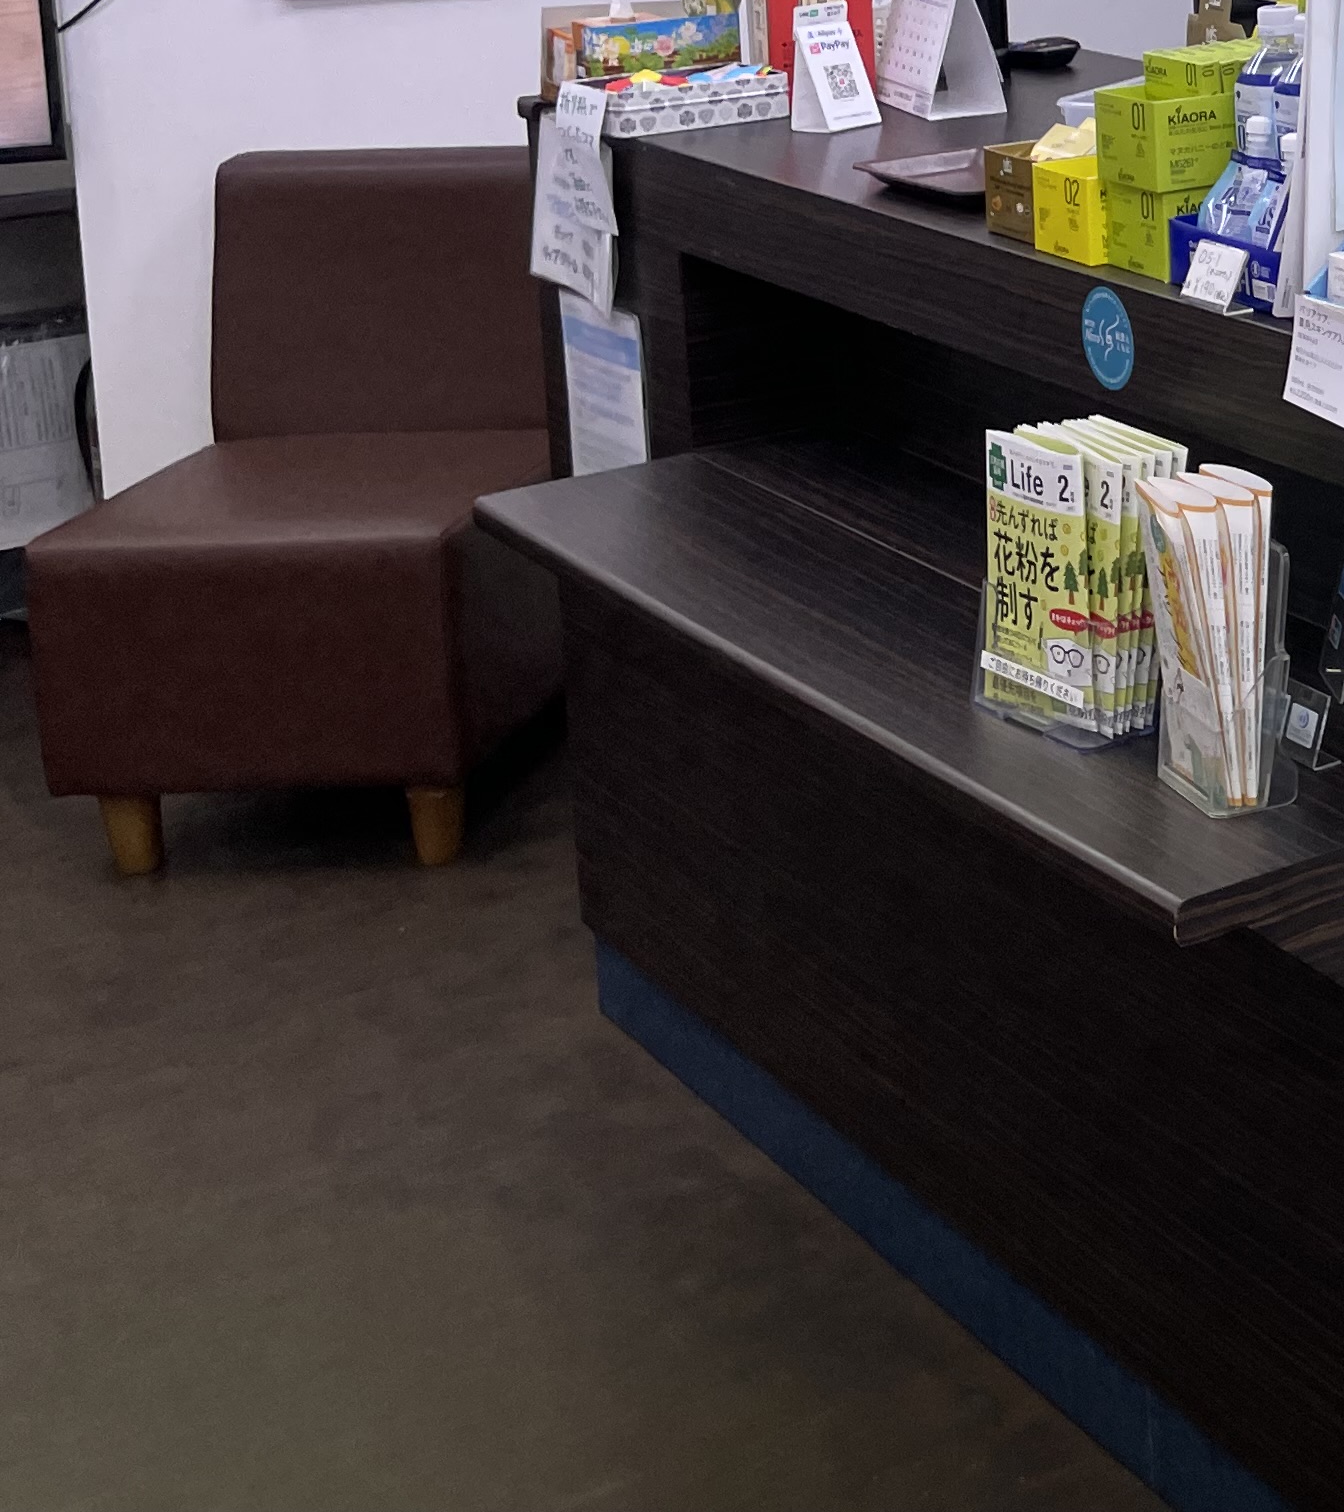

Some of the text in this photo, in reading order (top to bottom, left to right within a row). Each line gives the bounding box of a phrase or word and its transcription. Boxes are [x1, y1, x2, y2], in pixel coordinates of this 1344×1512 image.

[820, 38, 851, 52] PayPay
[1131, 103, 1146, 131] 01
[1168, 105, 1217, 126] KIAORA
[1064, 178, 1081, 207] 02
[1141, 191, 1155, 221] 01
[1010, 459, 1044, 497] Life
[993, 527, 1060, 593] 花粉を
[996, 578, 1039, 631] 制す
